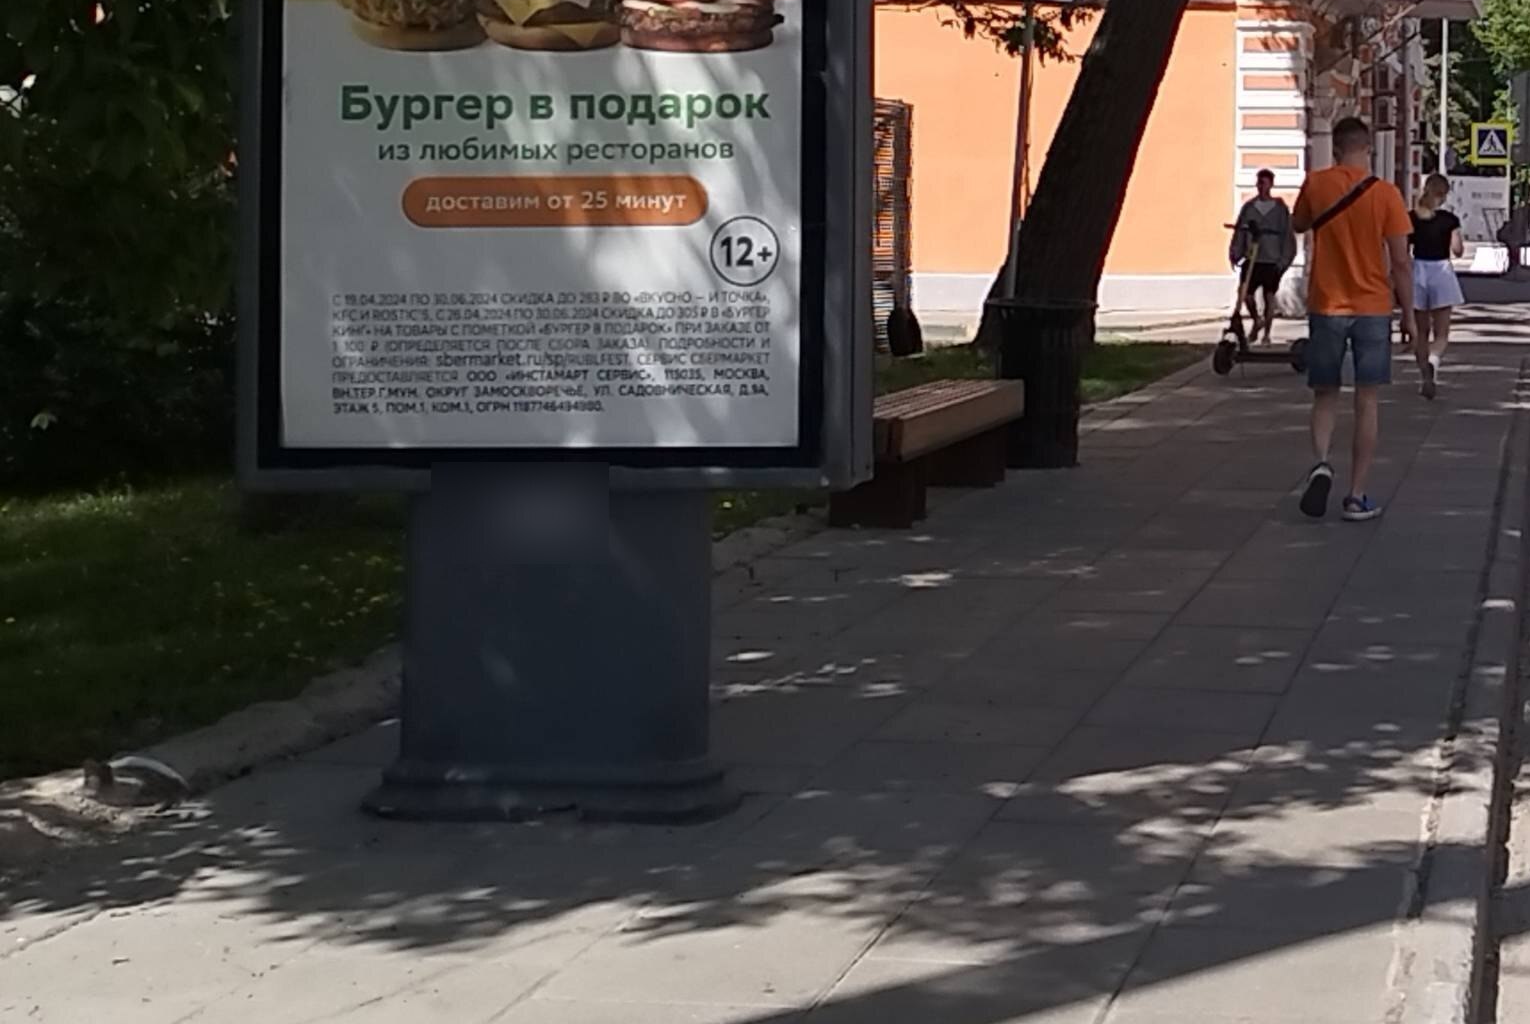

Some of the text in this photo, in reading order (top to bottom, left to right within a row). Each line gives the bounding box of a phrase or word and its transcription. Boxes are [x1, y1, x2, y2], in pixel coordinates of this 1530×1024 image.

[340, 84, 770, 132] Бургер в подарок
[377, 138, 734, 164] из любимых ресторанов
[425, 191, 687, 213] доставим от 25 минут
[720, 237, 773, 267] 12+
[411, 294, 430, 305] ПО
[501, 292, 554, 304] СКИДКА
[558, 292, 576, 305] ДО
[709, 292, 718, 303] И
[361, 309, 369, 320] И
[436, 309, 446, 320] С
[515, 308, 533, 319] ПО
[601, 308, 654, 320] СКИДКА
[656, 307, 674, 319] ДО
[711, 307, 718, 318] В
[374, 325, 392, 335] НА
[396, 325, 447, 335] ТОВАРЫ
[451, 325, 460, 335] С
[463, 323, 535, 335] ПОМЕТКОЙ
[675, 323, 701, 333] ПРИ
[705, 322, 751, 333] ЗАКАЗЕ
[755, 322, 770, 333] ОТ
[497, 339, 541, 351] ПОСЛЕ
[659, 337, 755, 349] ПОДРОБНОСТИ
[762, 337, 770, 348] И
[637, 353, 687, 365] СЕРВИС
[333, 371, 458, 383] ПРЕДОСТАВЛЯЕТСЯ
[467, 370, 497, 382] ООО
[426, 387, 468, 398] ОКРУГ
[333, 403, 368, 414] ЭТАЖ
[476, 401, 509, 412] ОГРН
